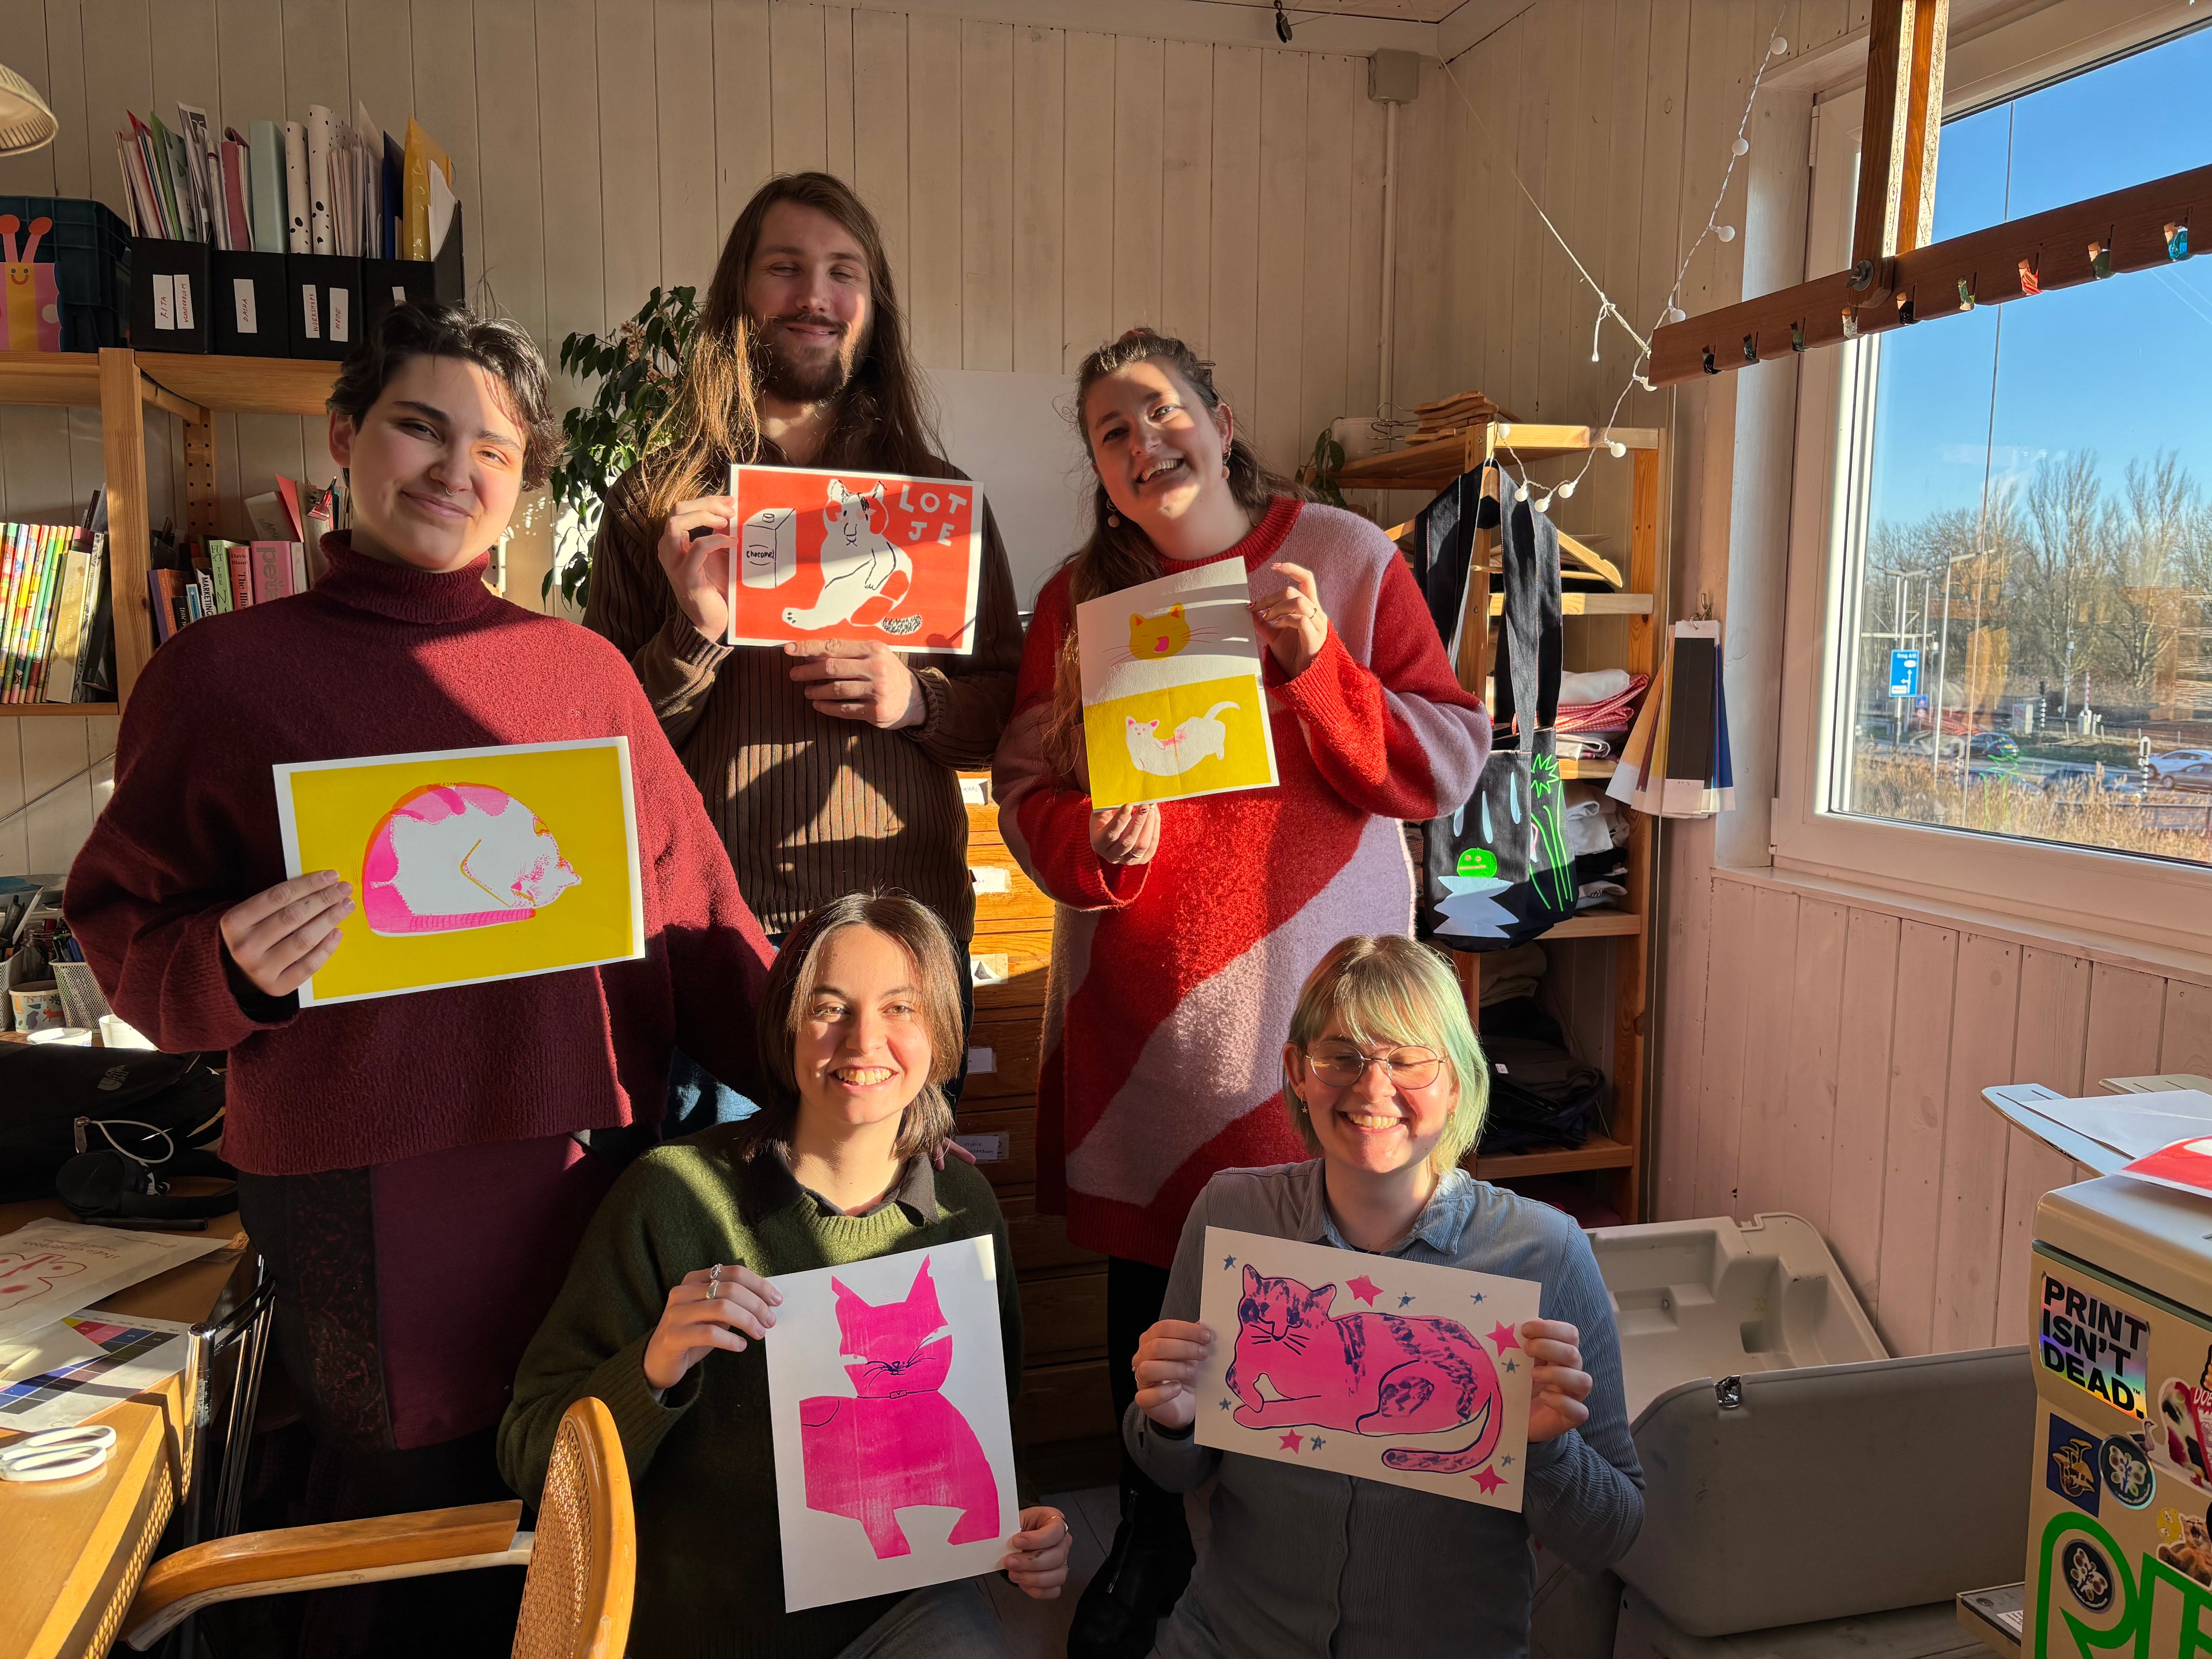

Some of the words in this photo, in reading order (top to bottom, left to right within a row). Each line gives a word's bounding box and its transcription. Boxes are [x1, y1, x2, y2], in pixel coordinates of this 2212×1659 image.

[160, 296, 169, 319] RITA
[309, 293, 319, 332] WORKSHOPS
[899, 484, 967, 514] LOT
[908, 521, 955, 547] JE
[746, 548, 774, 559] Chocomel
[238, 571, 246, 589] The
[201, 577, 214, 616] MARKETING
[86, 1249, 121, 1259] studio
[2043, 1275, 2149, 1351] PRINT
[2043, 1339, 2145, 1419] DEAD.
